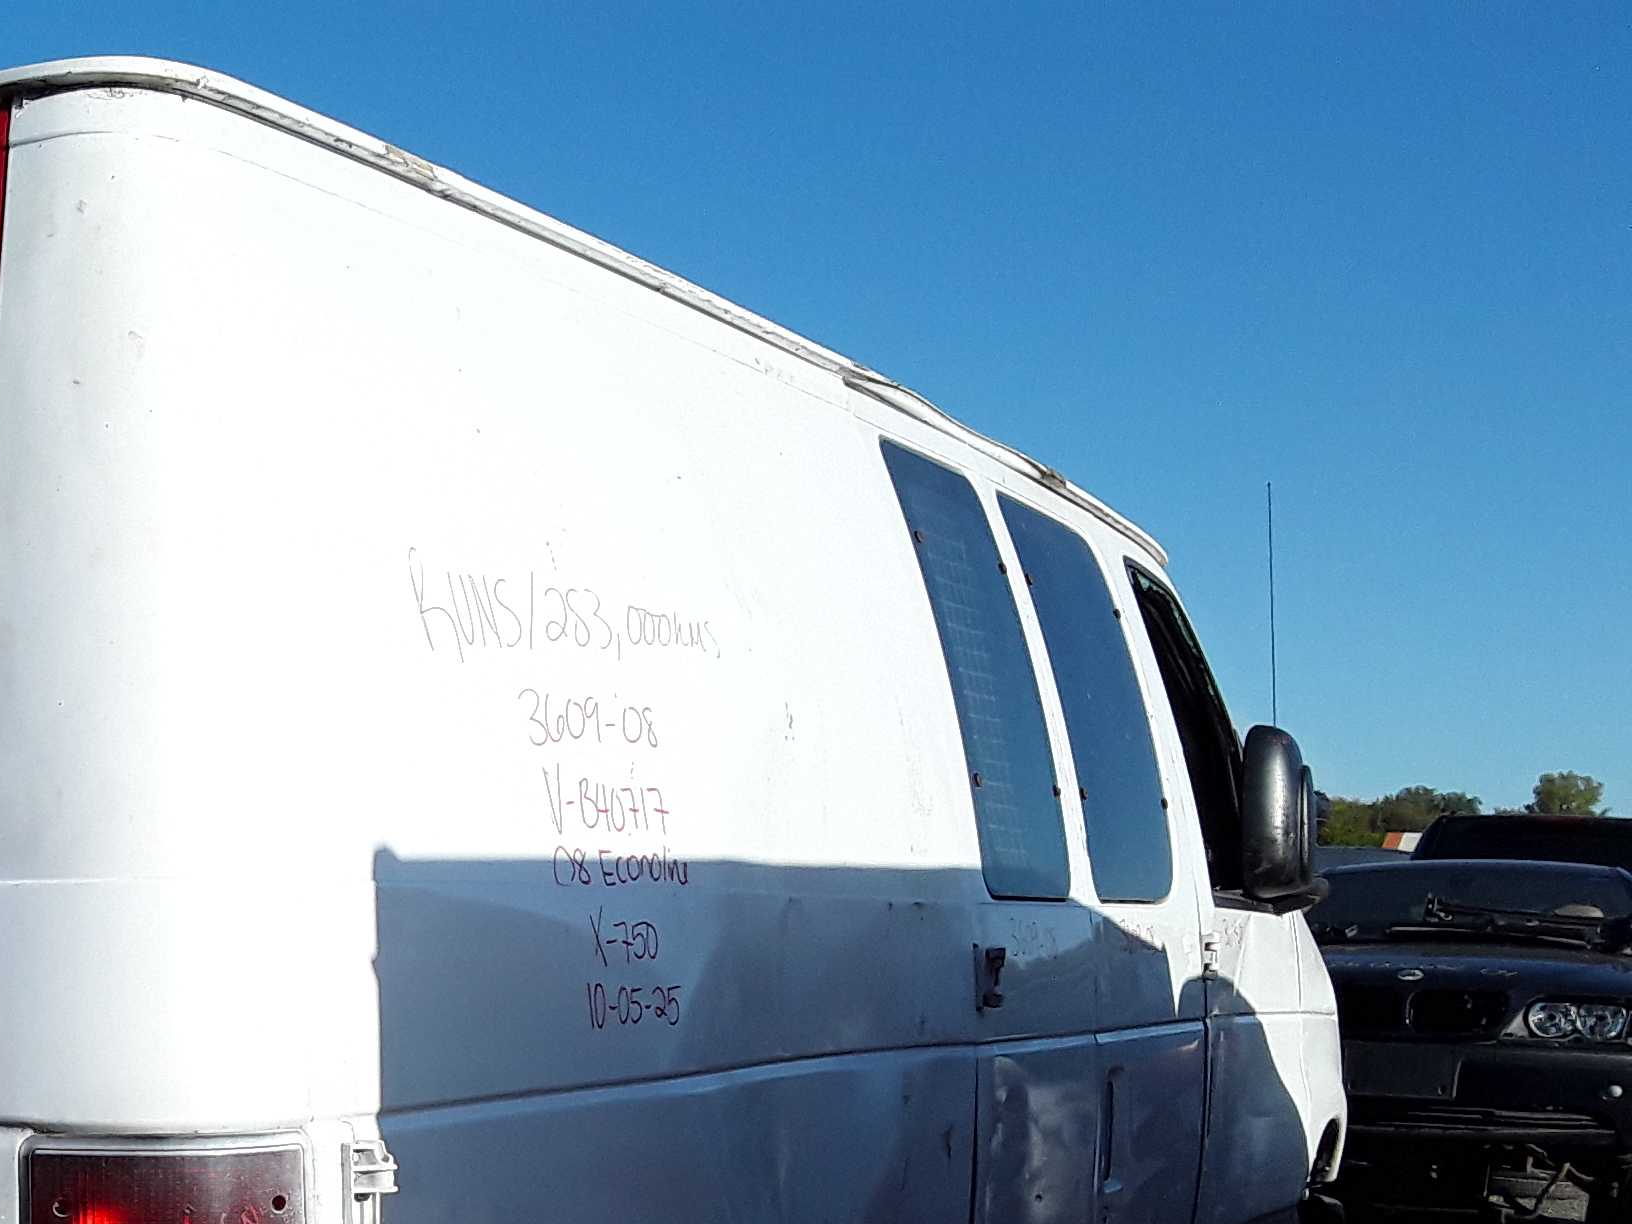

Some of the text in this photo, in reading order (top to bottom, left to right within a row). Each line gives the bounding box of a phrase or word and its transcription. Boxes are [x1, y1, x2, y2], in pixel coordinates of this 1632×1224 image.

[517, 688, 658, 748] 3609-08
[553, 845, 592, 887] 08
[585, 982, 682, 1030] 10-05-25
